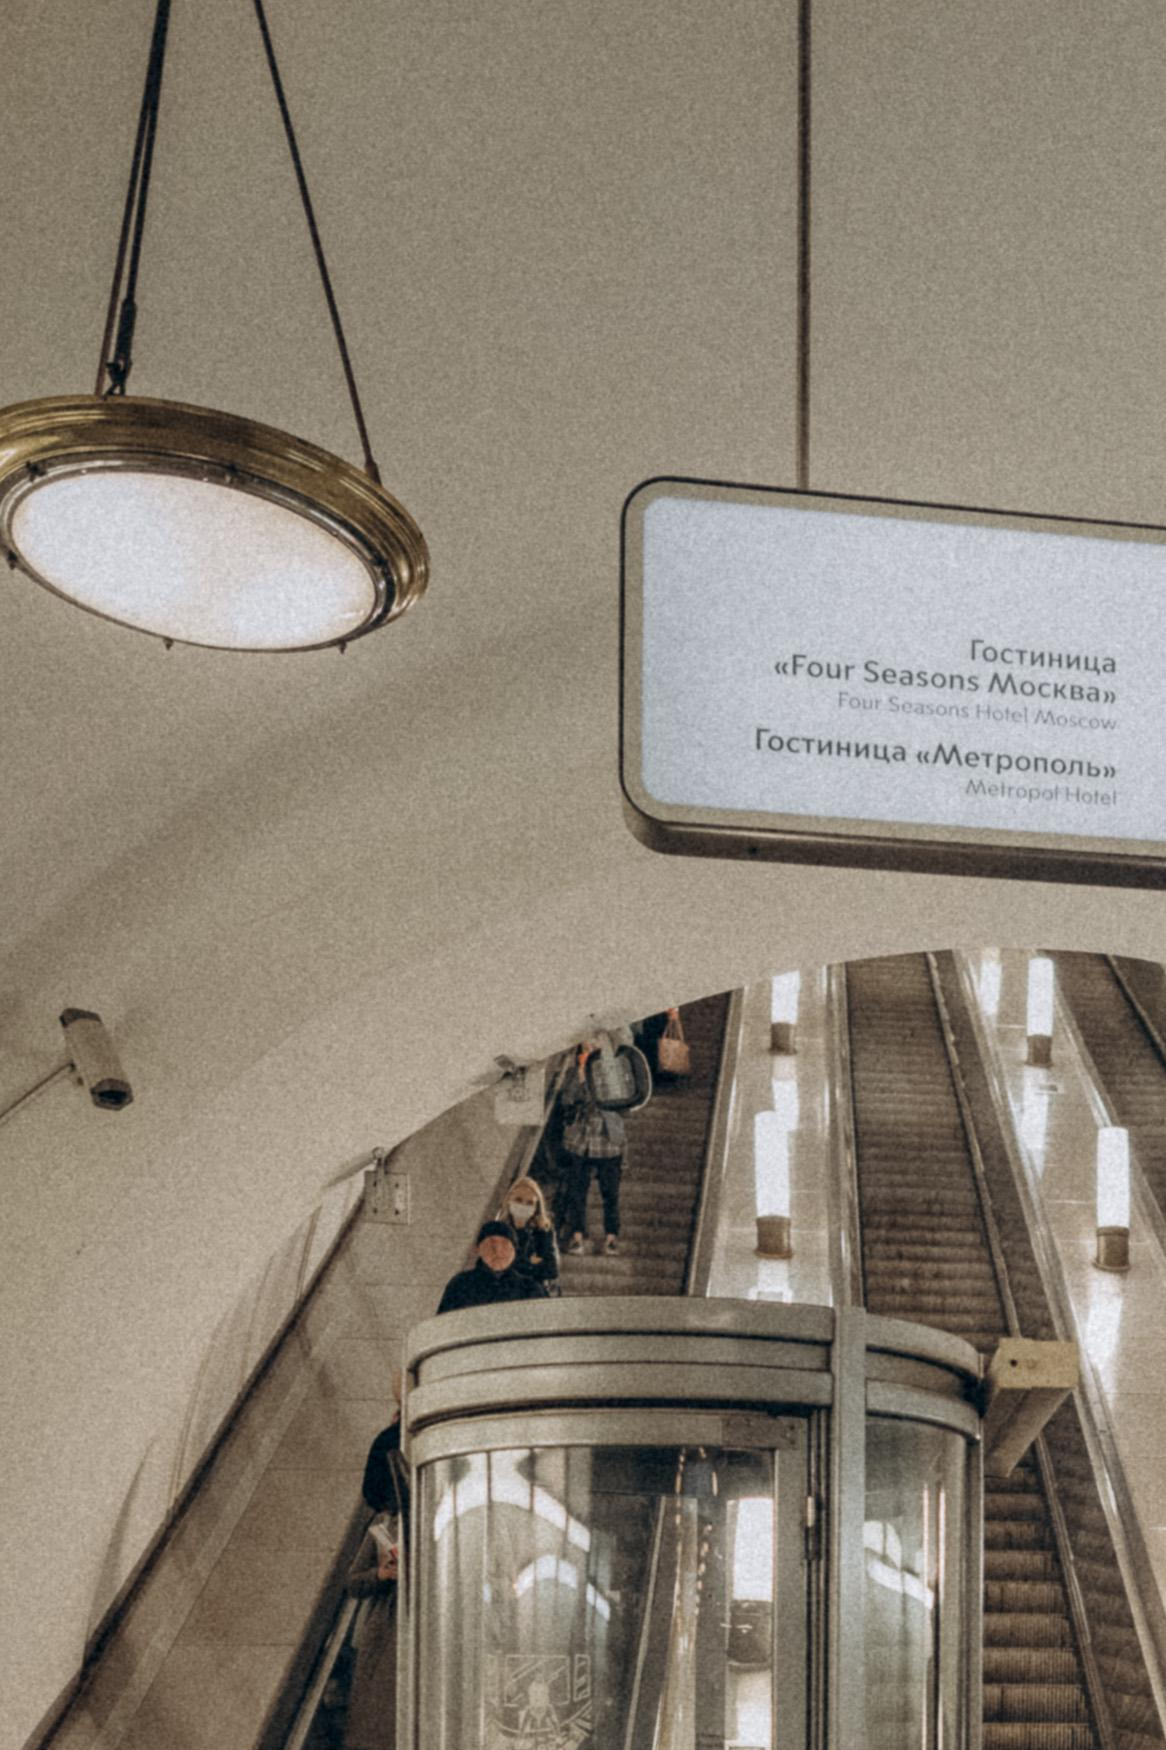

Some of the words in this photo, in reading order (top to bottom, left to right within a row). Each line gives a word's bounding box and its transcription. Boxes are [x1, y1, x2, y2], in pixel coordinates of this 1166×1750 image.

[971, 639, 1116, 675] Гостиница
[774, 654, 855, 680] «Four
[864, 660, 979, 692] Seasons
[988, 672, 1116, 704] Москва»
[838, 691, 882, 710] Four
[888, 696, 969, 718] Seasons
[976, 704, 1028, 724] Hotel
[1034, 709, 1117, 730] Moscow
[756, 729, 906, 764] Гостиница
[917, 743, 1115, 778] «Метрополь»
[965, 779, 1059, 803] Metropol
[1066, 786, 1116, 805] Hotel
